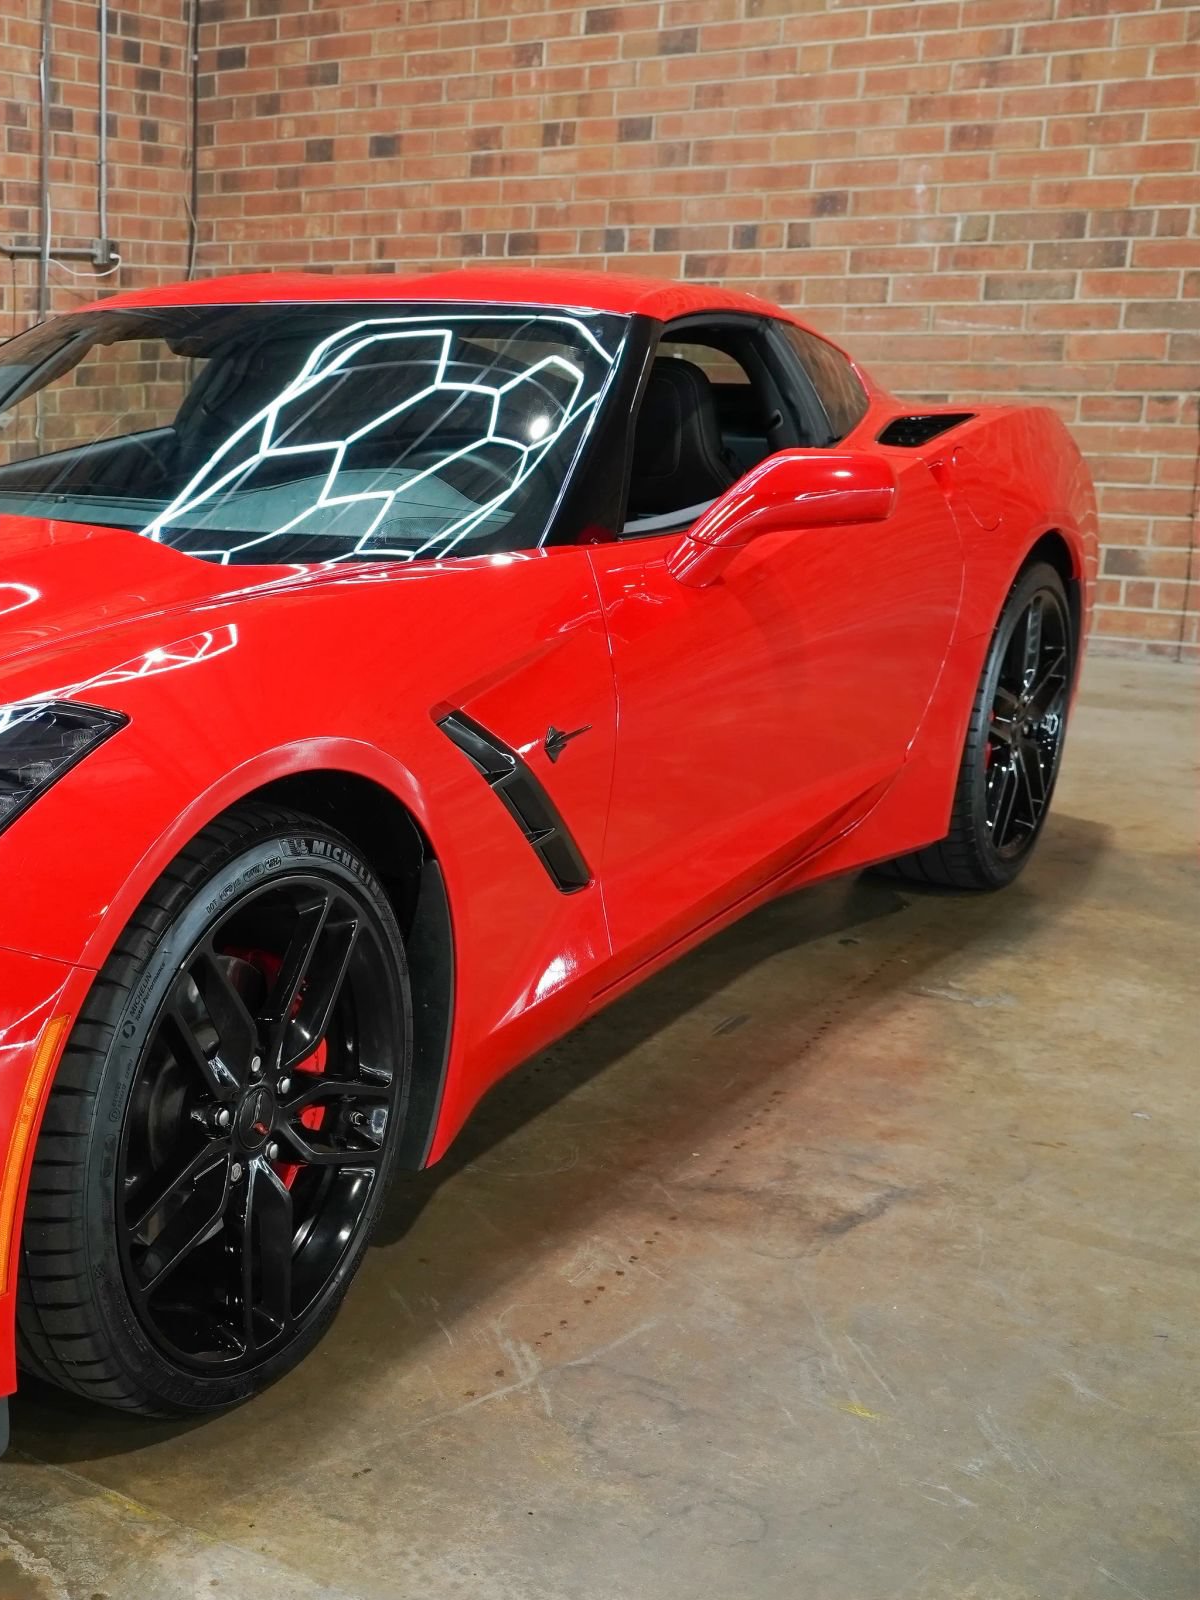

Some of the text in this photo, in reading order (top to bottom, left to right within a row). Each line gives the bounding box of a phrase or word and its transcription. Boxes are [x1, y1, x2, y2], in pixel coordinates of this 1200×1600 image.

[311, 840, 380, 897] MICHELIN
[129, 971, 152, 1017] MICHELIN
[135, 961, 166, 1021] Total Performance
